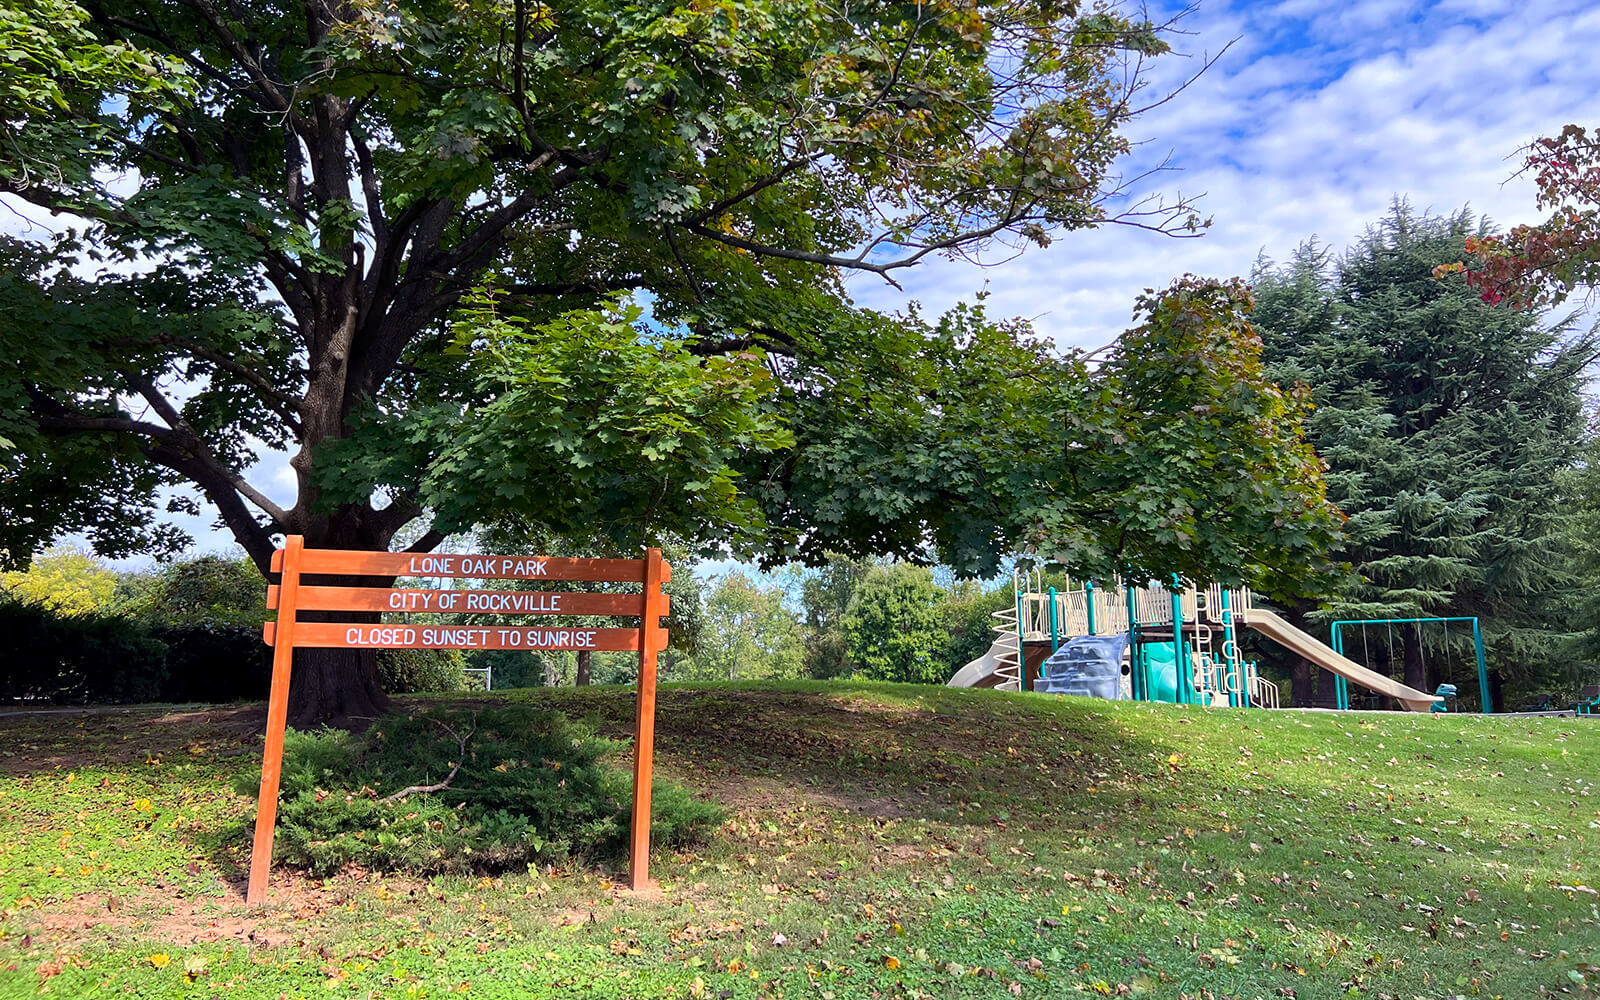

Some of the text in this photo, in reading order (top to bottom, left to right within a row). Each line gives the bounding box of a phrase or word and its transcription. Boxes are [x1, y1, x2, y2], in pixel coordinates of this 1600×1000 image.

[410, 557, 547, 576] LONE OAK PARK
[389, 592, 561, 611] CITY OF ROCKVILLE
[346, 627, 596, 647] CLOSED SUNSET TO SUNRISE
